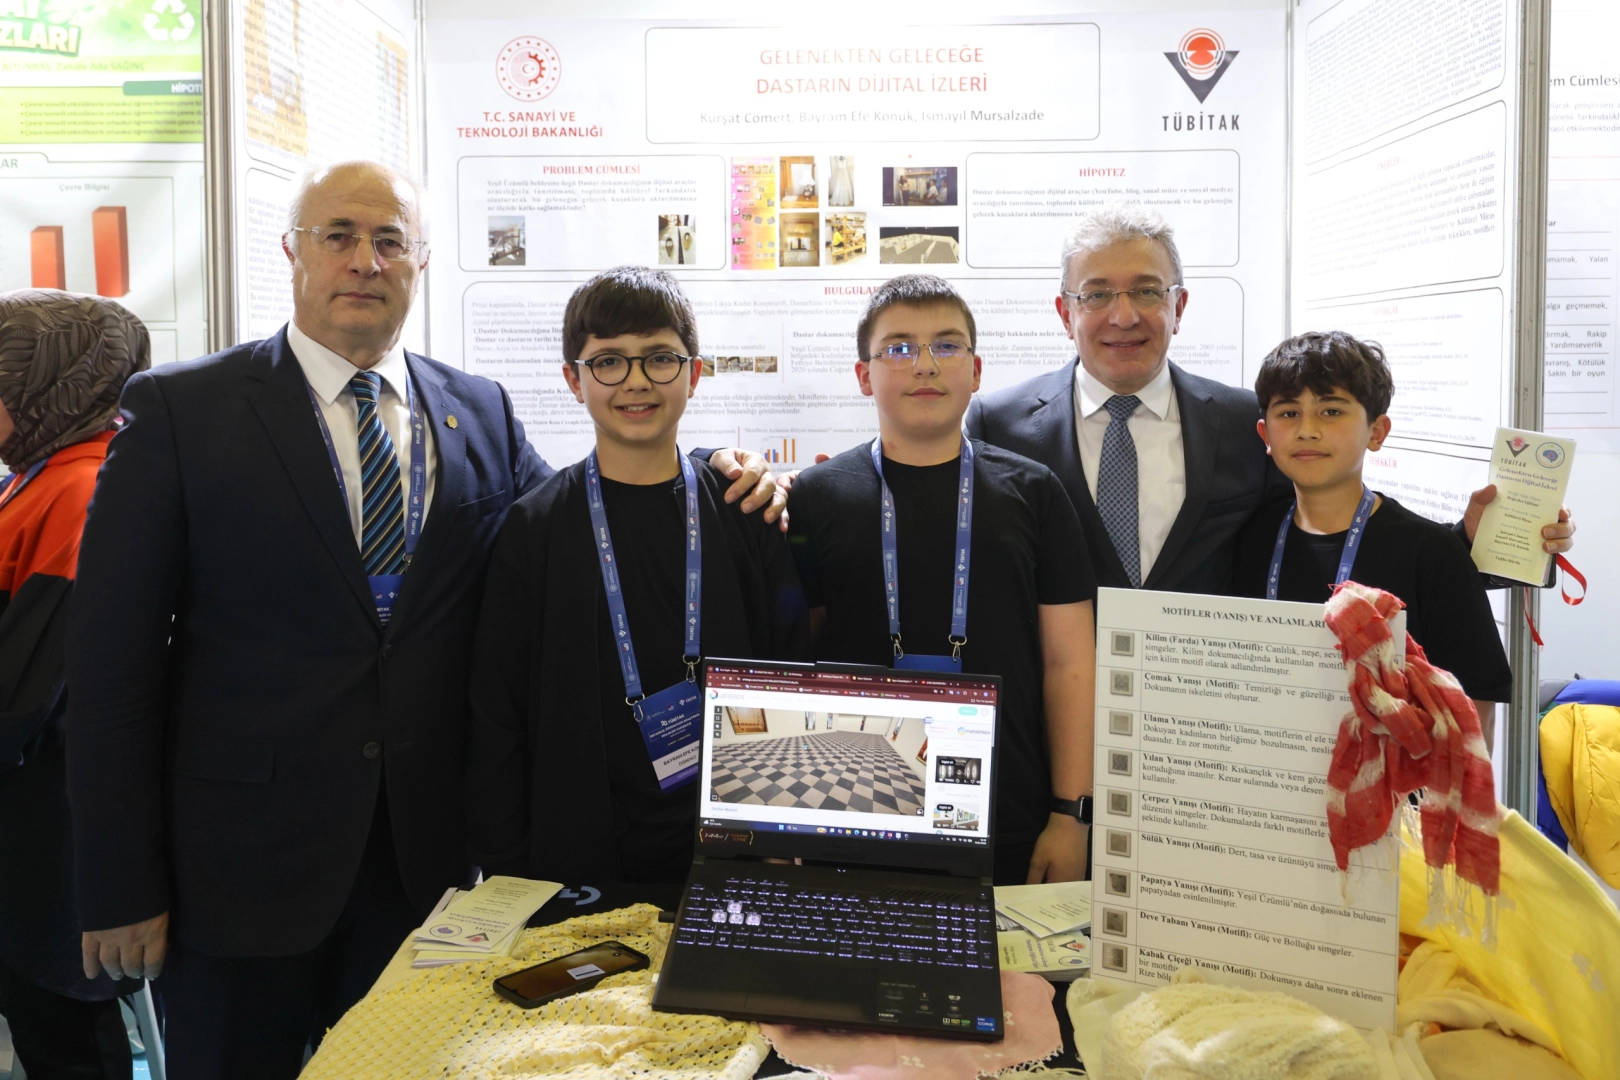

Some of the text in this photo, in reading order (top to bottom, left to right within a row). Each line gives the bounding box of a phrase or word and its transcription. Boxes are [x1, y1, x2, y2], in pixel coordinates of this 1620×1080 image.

[759, 44, 983, 64] GELENEKTEN GELECEĞE
[756, 74, 987, 93] DASTARIN DİJİTAL İZLERİ
[483, 110, 575, 122] T.C. SANAYİ VE
[700, 113, 740, 124] Kurşat
[744, 112, 793, 123] Cömert,
[799, 112, 846, 123] Bayram
[851, 110, 869, 121] Efe
[873, 111, 917, 121] Konuk,
[970, 110, 1044, 120] Mursalzade
[1163, 114, 1239, 131] TÜBİTAK
[458, 125, 602, 137] TEKNOLOJİ BAKANLIĞI
[542, 165, 640, 174] PROBLEM CÜMLESİ
[1079, 166, 1125, 176] HİPOTEZ
[84, 183, 110, 192] Bilgisi
[1566, 302, 1608, 311] geçmemek,
[1500, 458, 1527, 468] TÜBİTAK
[1161, 607, 1326, 627] MOTİFLER (YANIŞ) VE ANLAMLARI
[1145, 633, 1167, 641] Kilim
[1168, 636, 1199, 645] (Farda)
[1201, 638, 1226, 648] Yanışı
[1228, 641, 1263, 651] (Motifi):
[1265, 644, 1299, 654] Canlılık,
[1145, 645, 1178, 653] simgeler.
[1182, 646, 1204, 655] Kilim
[1274, 656, 1314, 666] kullanılan
[1159, 655, 1179, 663] kilim
[1205, 659, 1228, 668] olarak
[1144, 673, 1172, 683] Çomak
[1177, 676, 1201, 685] Yanışı
[1205, 679, 1239, 689] (Motifi):
[1245, 683, 1281, 695] Temizliği
[1300, 690, 1334, 701] güzelliği
[1144, 682, 1260, 702] Dokumanın iskeletini oluşturur.
[1143, 714, 1169, 723] Ulama
[1171, 717, 1196, 727] Yanışı
[1197, 720, 1231, 731] (Motifi):
[1234, 724, 1261, 735] Ulama,
[1263, 730, 1303, 739] motiflerin
[1142, 734, 1174, 744] duasıdır.
[1176, 737, 1186, 746] En
[1202, 743, 1232, 751] motiftir.
[664, 753, 682, 765] BAYRAM
[1143, 752, 1163, 762] Yılan
[1166, 756, 1191, 766] Yanışı
[1193, 760, 1227, 771] (Motifi):
[1231, 764, 1272, 776] Kıskançlık
[1287, 772, 1304, 781] kem
[1142, 773, 1177, 784] kullanılır.
[1141, 794, 1316, 825] Çerpez Yanışı (Motifi): Hayatın karmaşasını
[1141, 833, 1164, 843] Sülük
[1166, 837, 1190, 848] Yanışı
[1192, 842, 1226, 853] (Motifi):
[1228, 847, 1247, 857] Dert,
[1277, 856, 1314, 868] üzüntüyü
[1140, 874, 1172, 886] Papatya
[1174, 880, 1198, 891] Yanışı
[1200, 885, 1234, 897] (Motifi):
[1237, 890, 1257, 901] Yeşil
[1310, 904, 1350, 916] doğasında
[1352, 910, 1386, 922] bulunan
[1139, 911, 1158, 921] Deve
[1161, 915, 1188, 926] Tabanı
[1190, 920, 1215, 932] Yanışı
[1217, 926, 1251, 938] (Motifi):
[1253, 932, 1270, 942] Güç
[1283, 937, 1315, 950] Bolluğu
[1317, 946, 1353, 956] simgeler.
[1138, 967, 1155, 977] Rize
[1139, 948, 1382, 1001] Kabak Çiçeği Yanışı (Motifi): Dokumaya daha sonra eklenen
